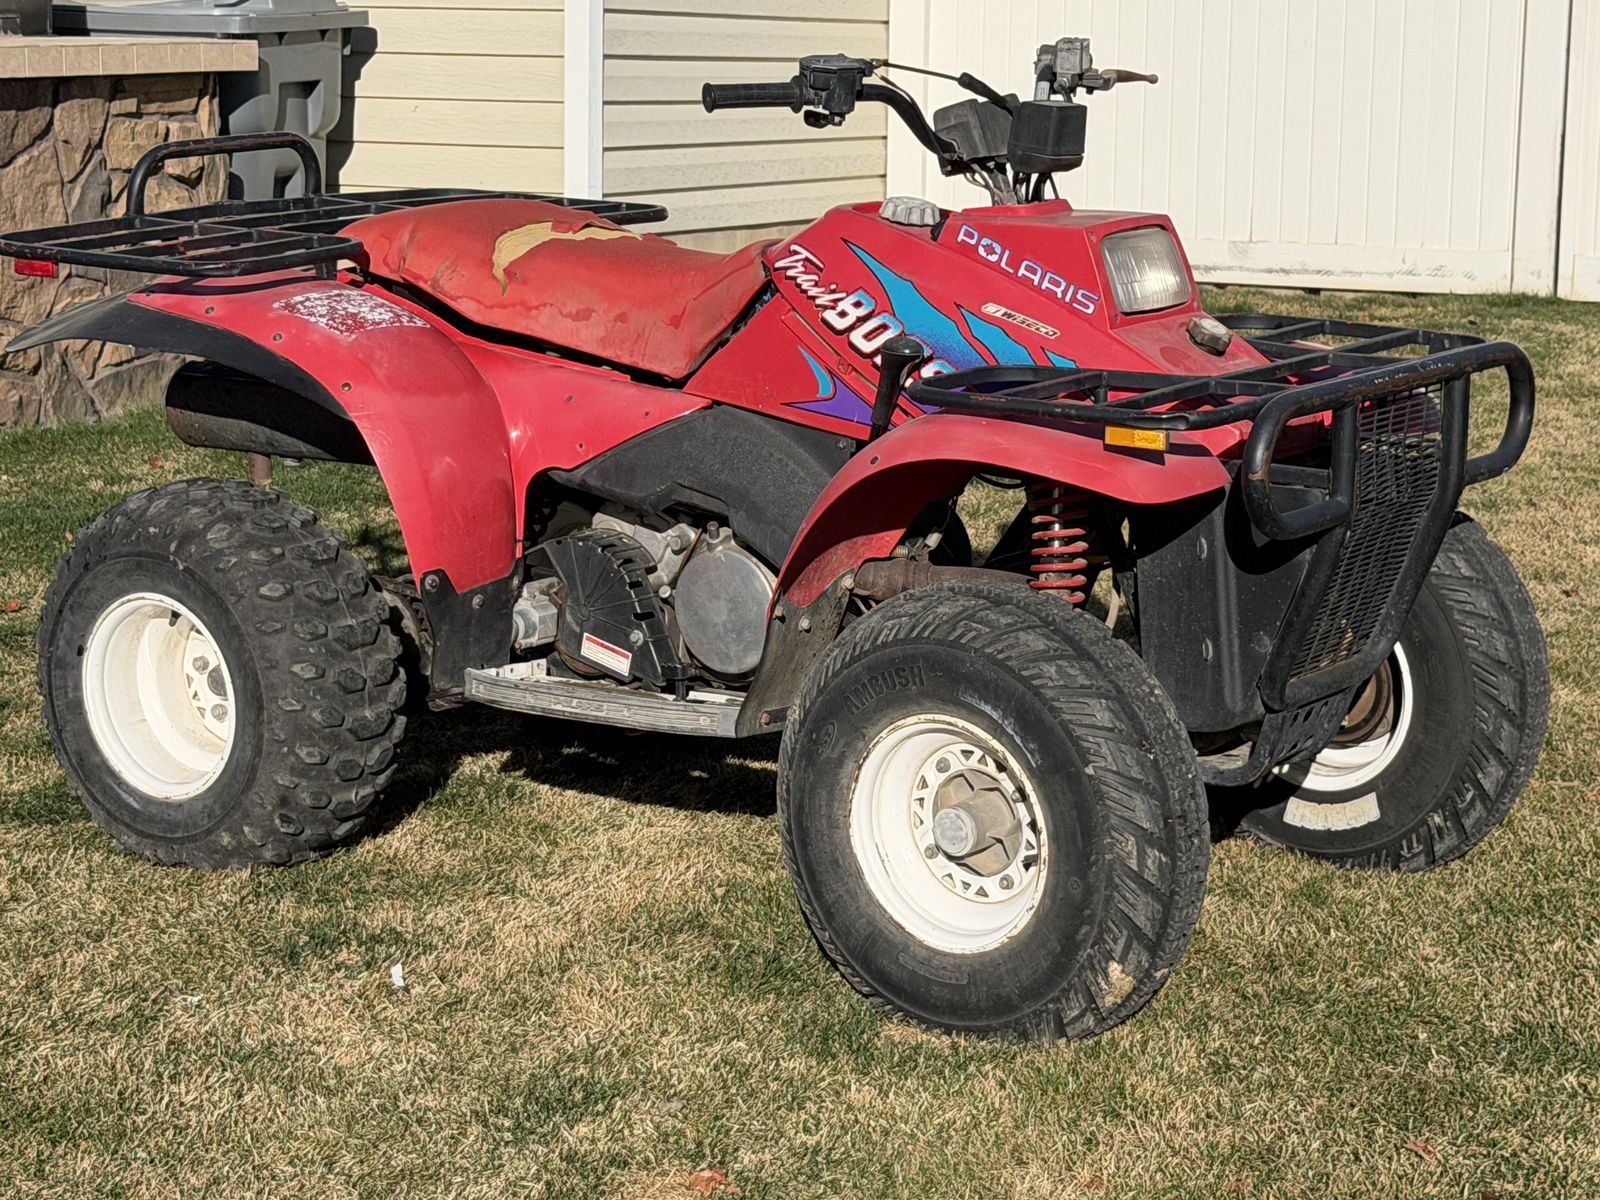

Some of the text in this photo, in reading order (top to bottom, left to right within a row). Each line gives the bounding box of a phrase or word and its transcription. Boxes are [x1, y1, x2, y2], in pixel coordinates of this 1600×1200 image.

[957, 223, 1100, 316] POLARIS
[773, 244, 959, 389] Trail BO
[842, 661, 926, 715] AMBUSH
